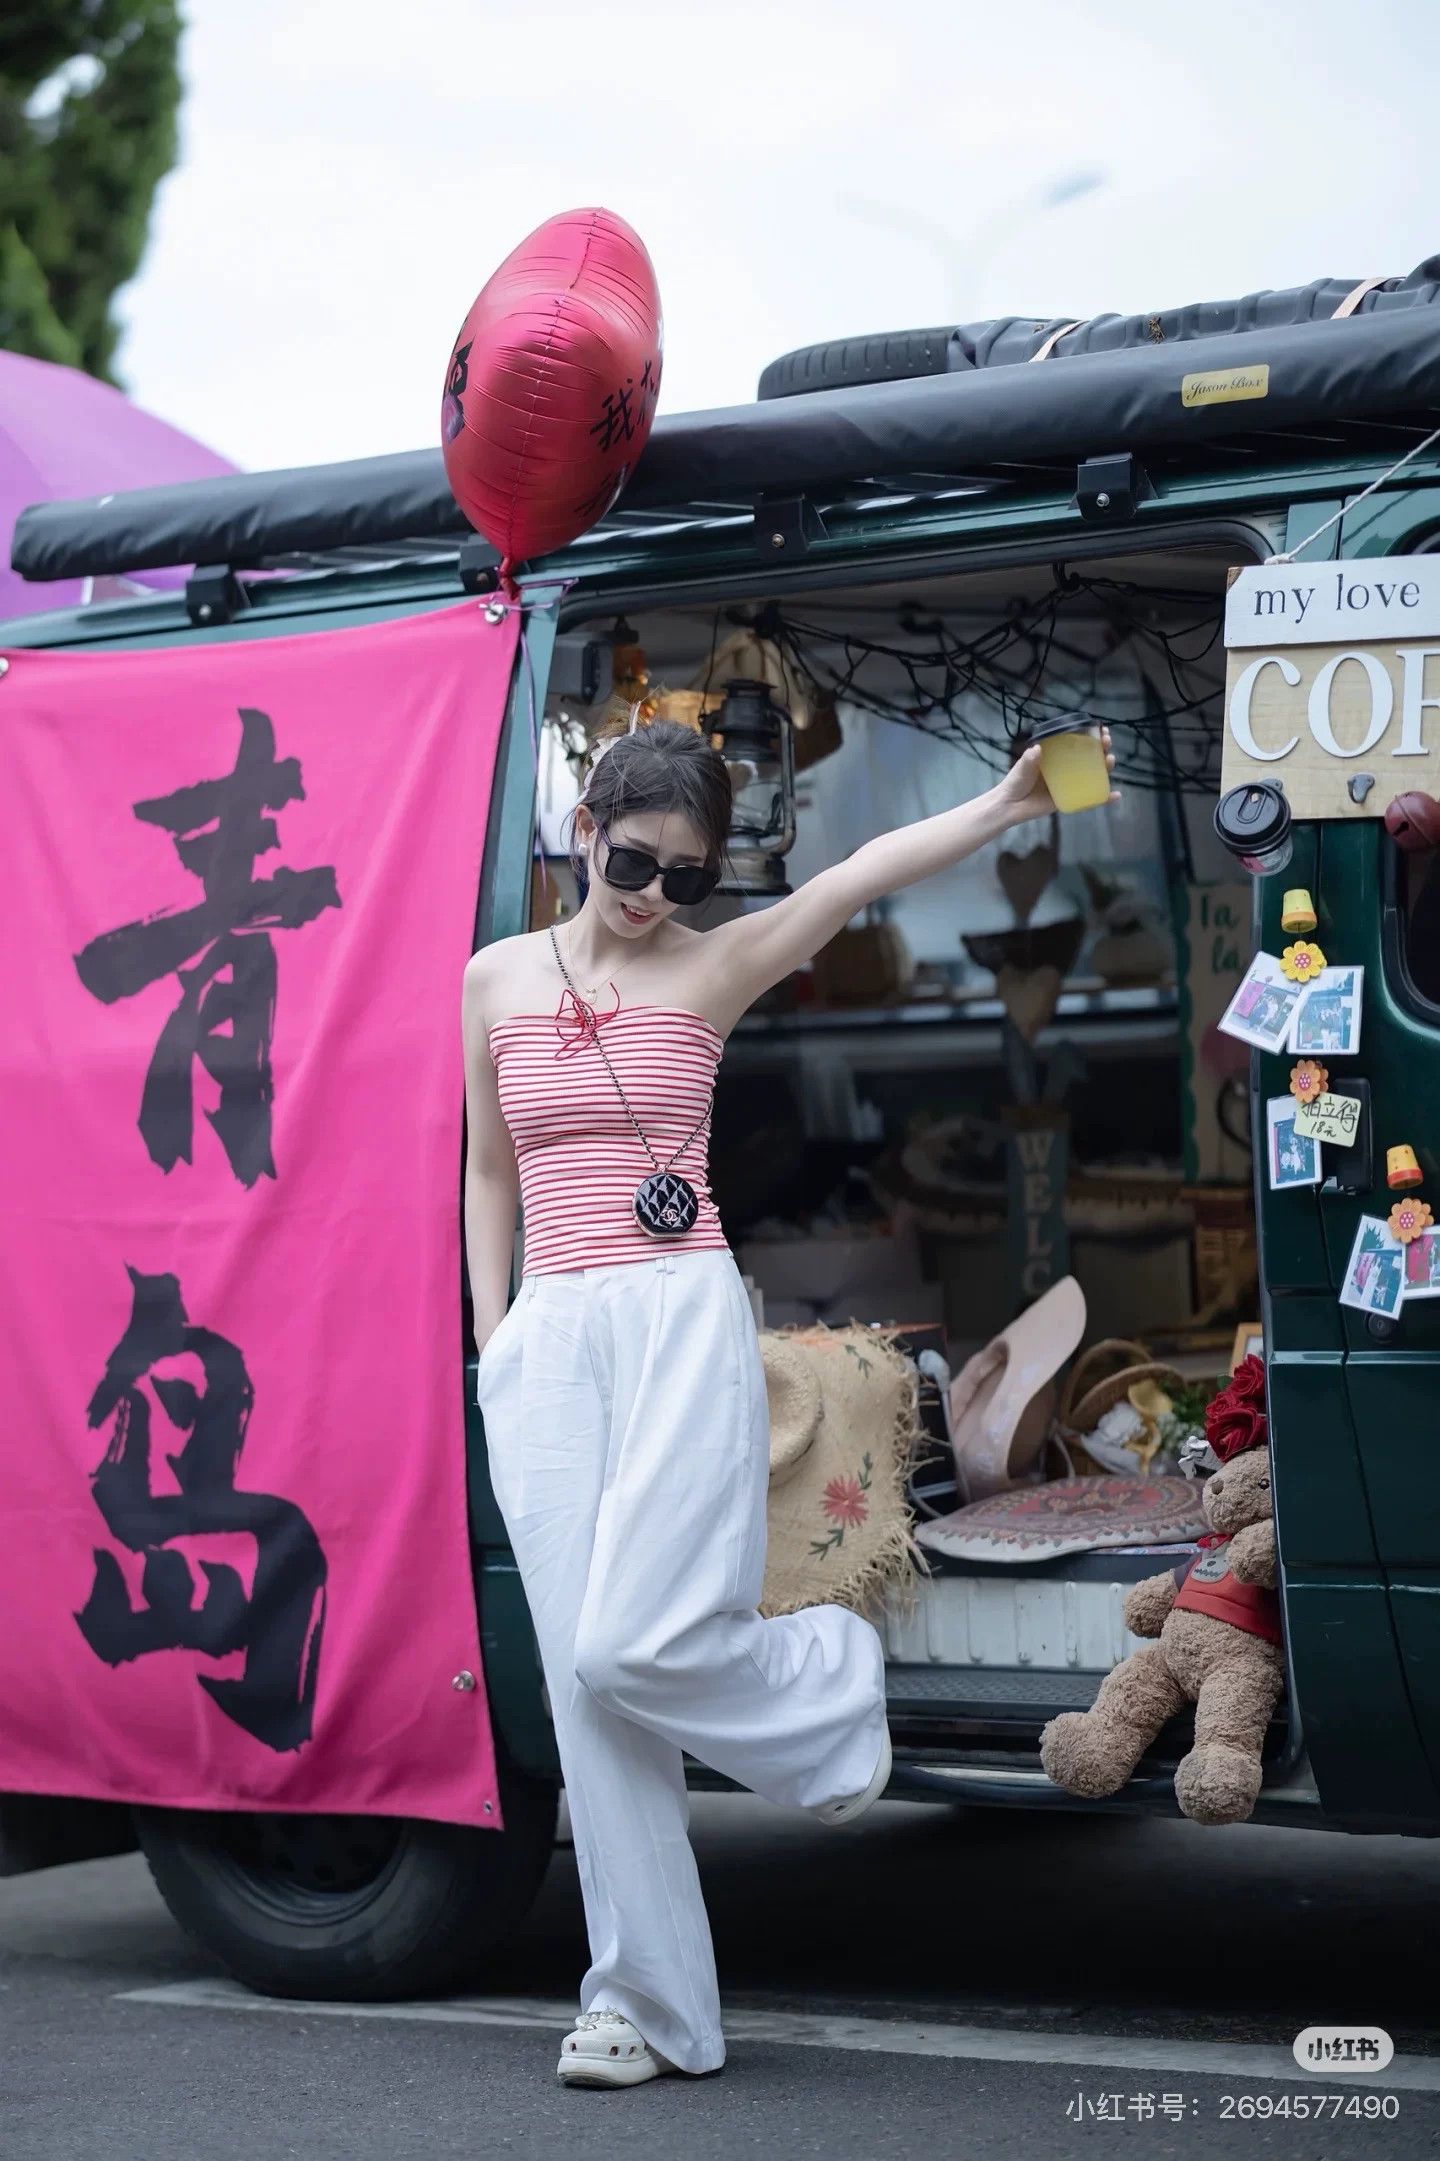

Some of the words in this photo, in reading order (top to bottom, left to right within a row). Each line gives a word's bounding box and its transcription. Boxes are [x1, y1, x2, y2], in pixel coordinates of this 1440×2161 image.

[1186, 381, 1227, 400] Jason
[1231, 376, 1264, 389] Box
[1253, 587, 1316, 624] my
[1335, 573, 1420, 611] love
[1300, 1096, 1358, 1134] 拍立得
[1310, 1120, 1337, 1138] 18元
[73, 706, 343, 1752] 青岛
